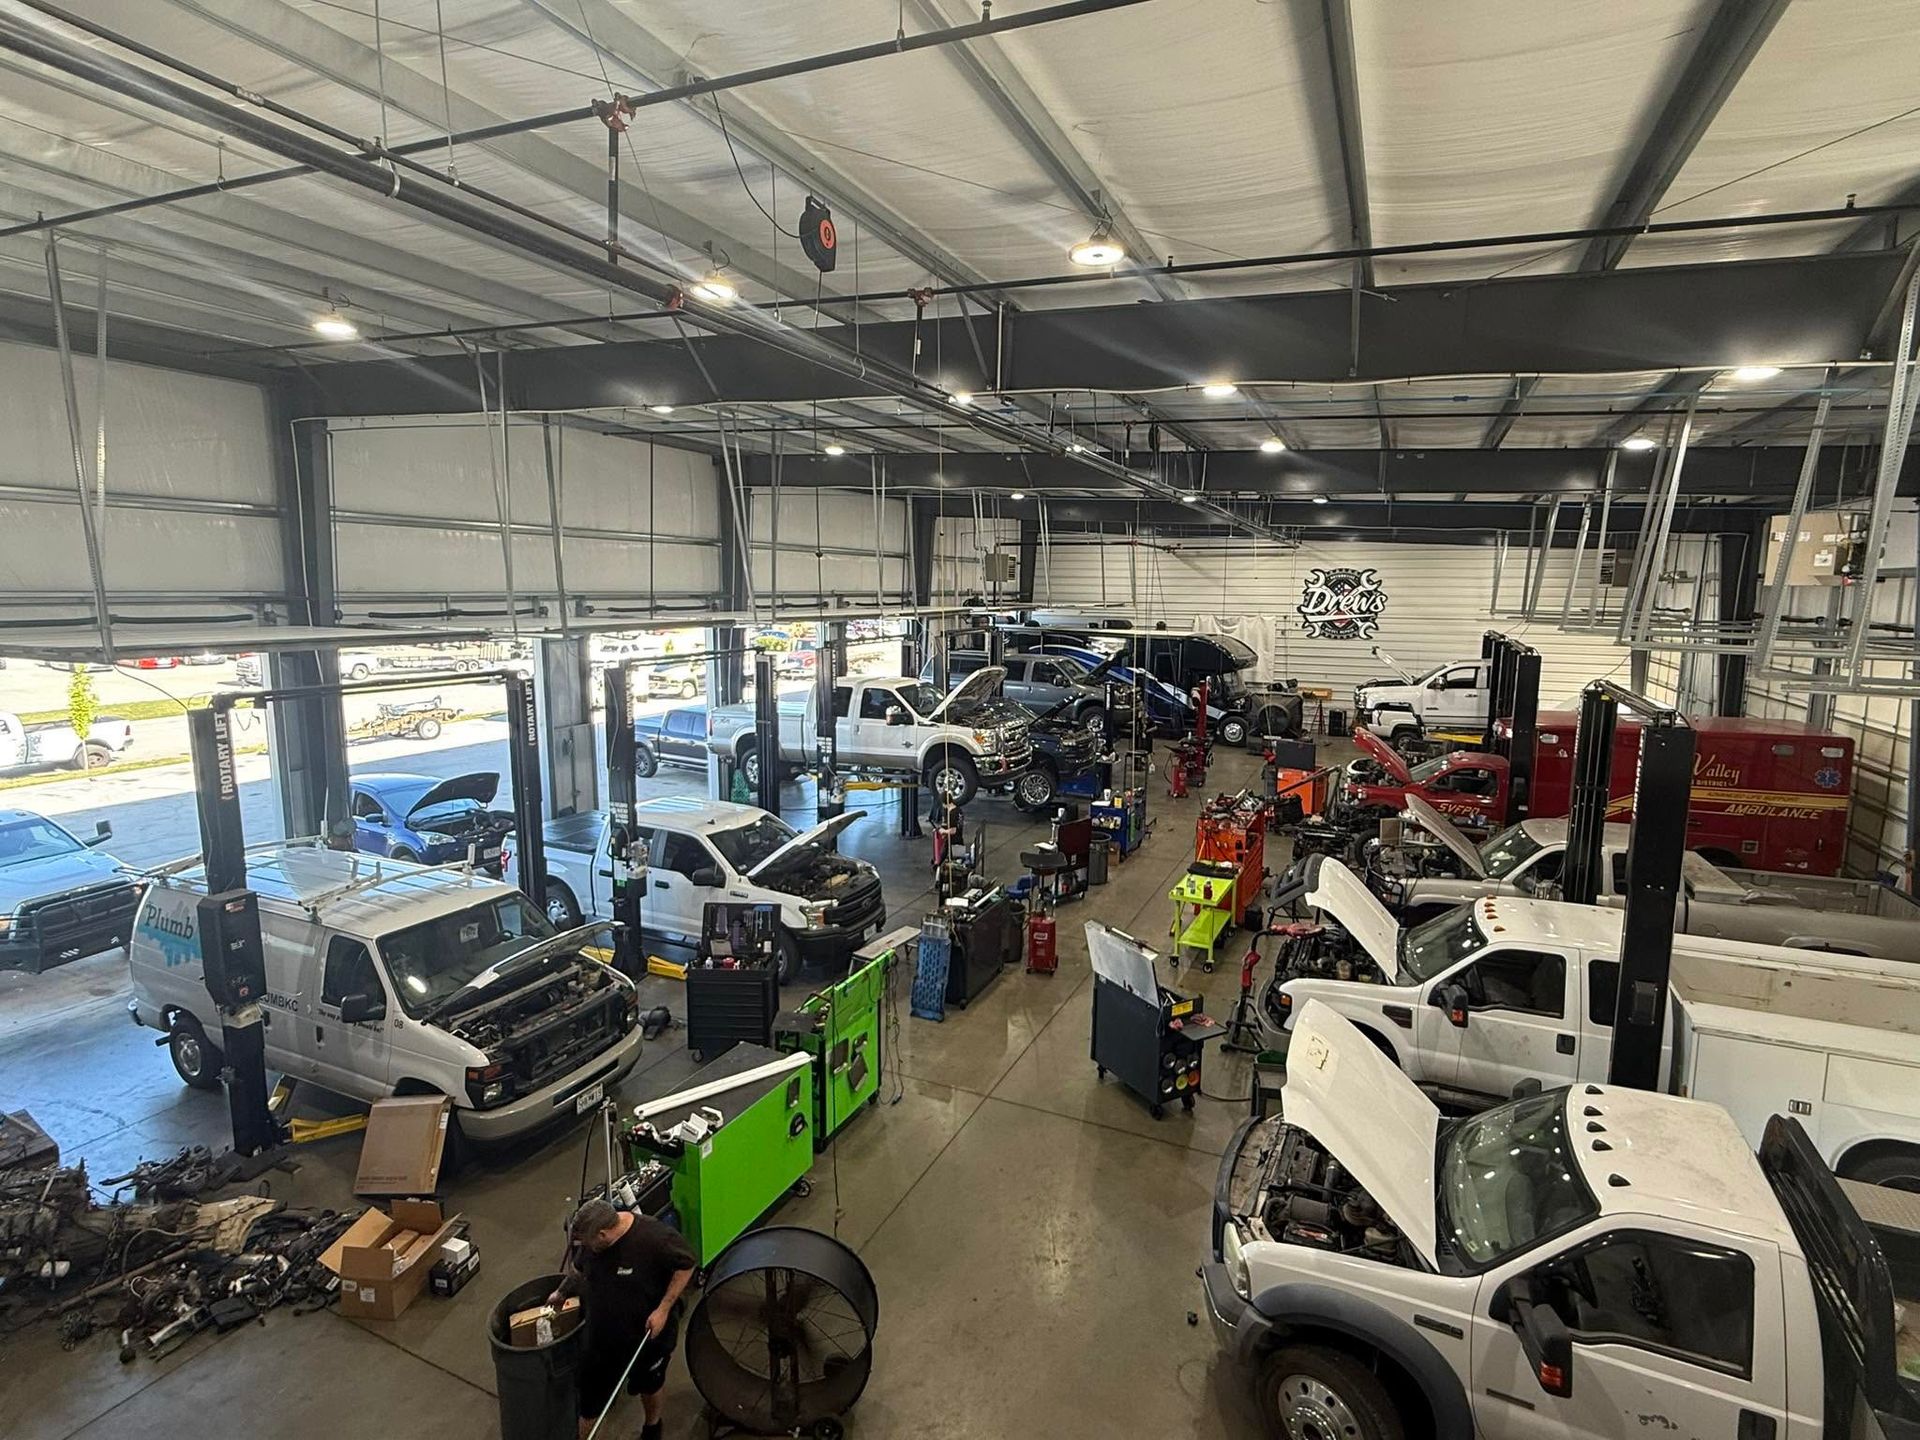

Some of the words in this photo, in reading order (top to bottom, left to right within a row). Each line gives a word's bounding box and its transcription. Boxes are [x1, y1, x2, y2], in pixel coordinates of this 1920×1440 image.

[525, 680, 534, 701] LIFT
[214, 712, 228, 740] LIFT
[526, 703, 536, 741] ROTARY
[217, 742, 234, 794] ROTARY
[1693, 752, 1741, 787] Valley
[1437, 802, 1480, 815] SVFPD
[1724, 803, 1823, 820] AMBULANCE
[145, 903, 194, 940] Plumb
[264, 993, 298, 1012] UMBKC
